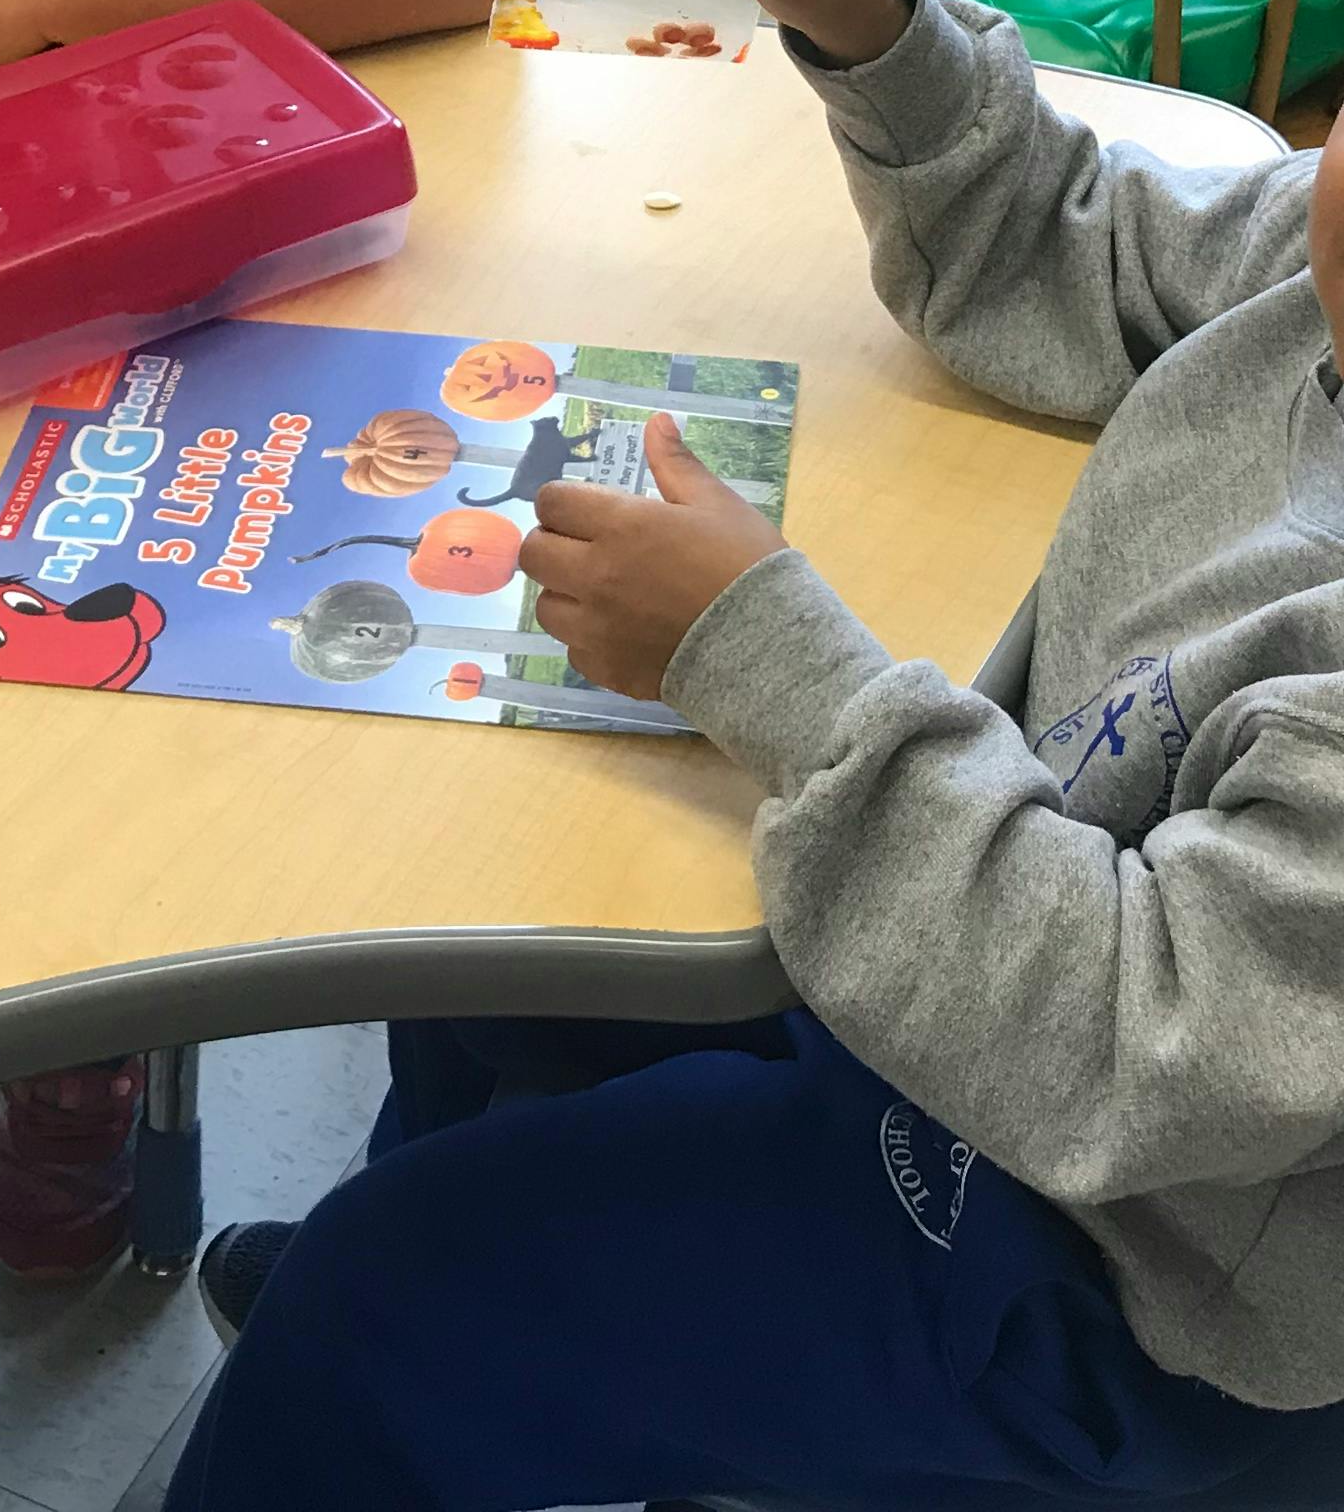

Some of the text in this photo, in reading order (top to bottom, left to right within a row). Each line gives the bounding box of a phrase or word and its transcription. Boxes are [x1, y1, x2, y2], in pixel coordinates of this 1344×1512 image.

[522, 374, 547, 388] 5
[38, 540, 100, 584] My
[107, 353, 171, 429] World
[403, 447, 428, 461] 4
[619, 434, 638, 486] they great?
[4, 421, 63, 525] SCHOLASTIC
[138, 427, 239, 565] 5 Little
[448, 544, 473, 559] 3
[355, 624, 382, 640] 2
